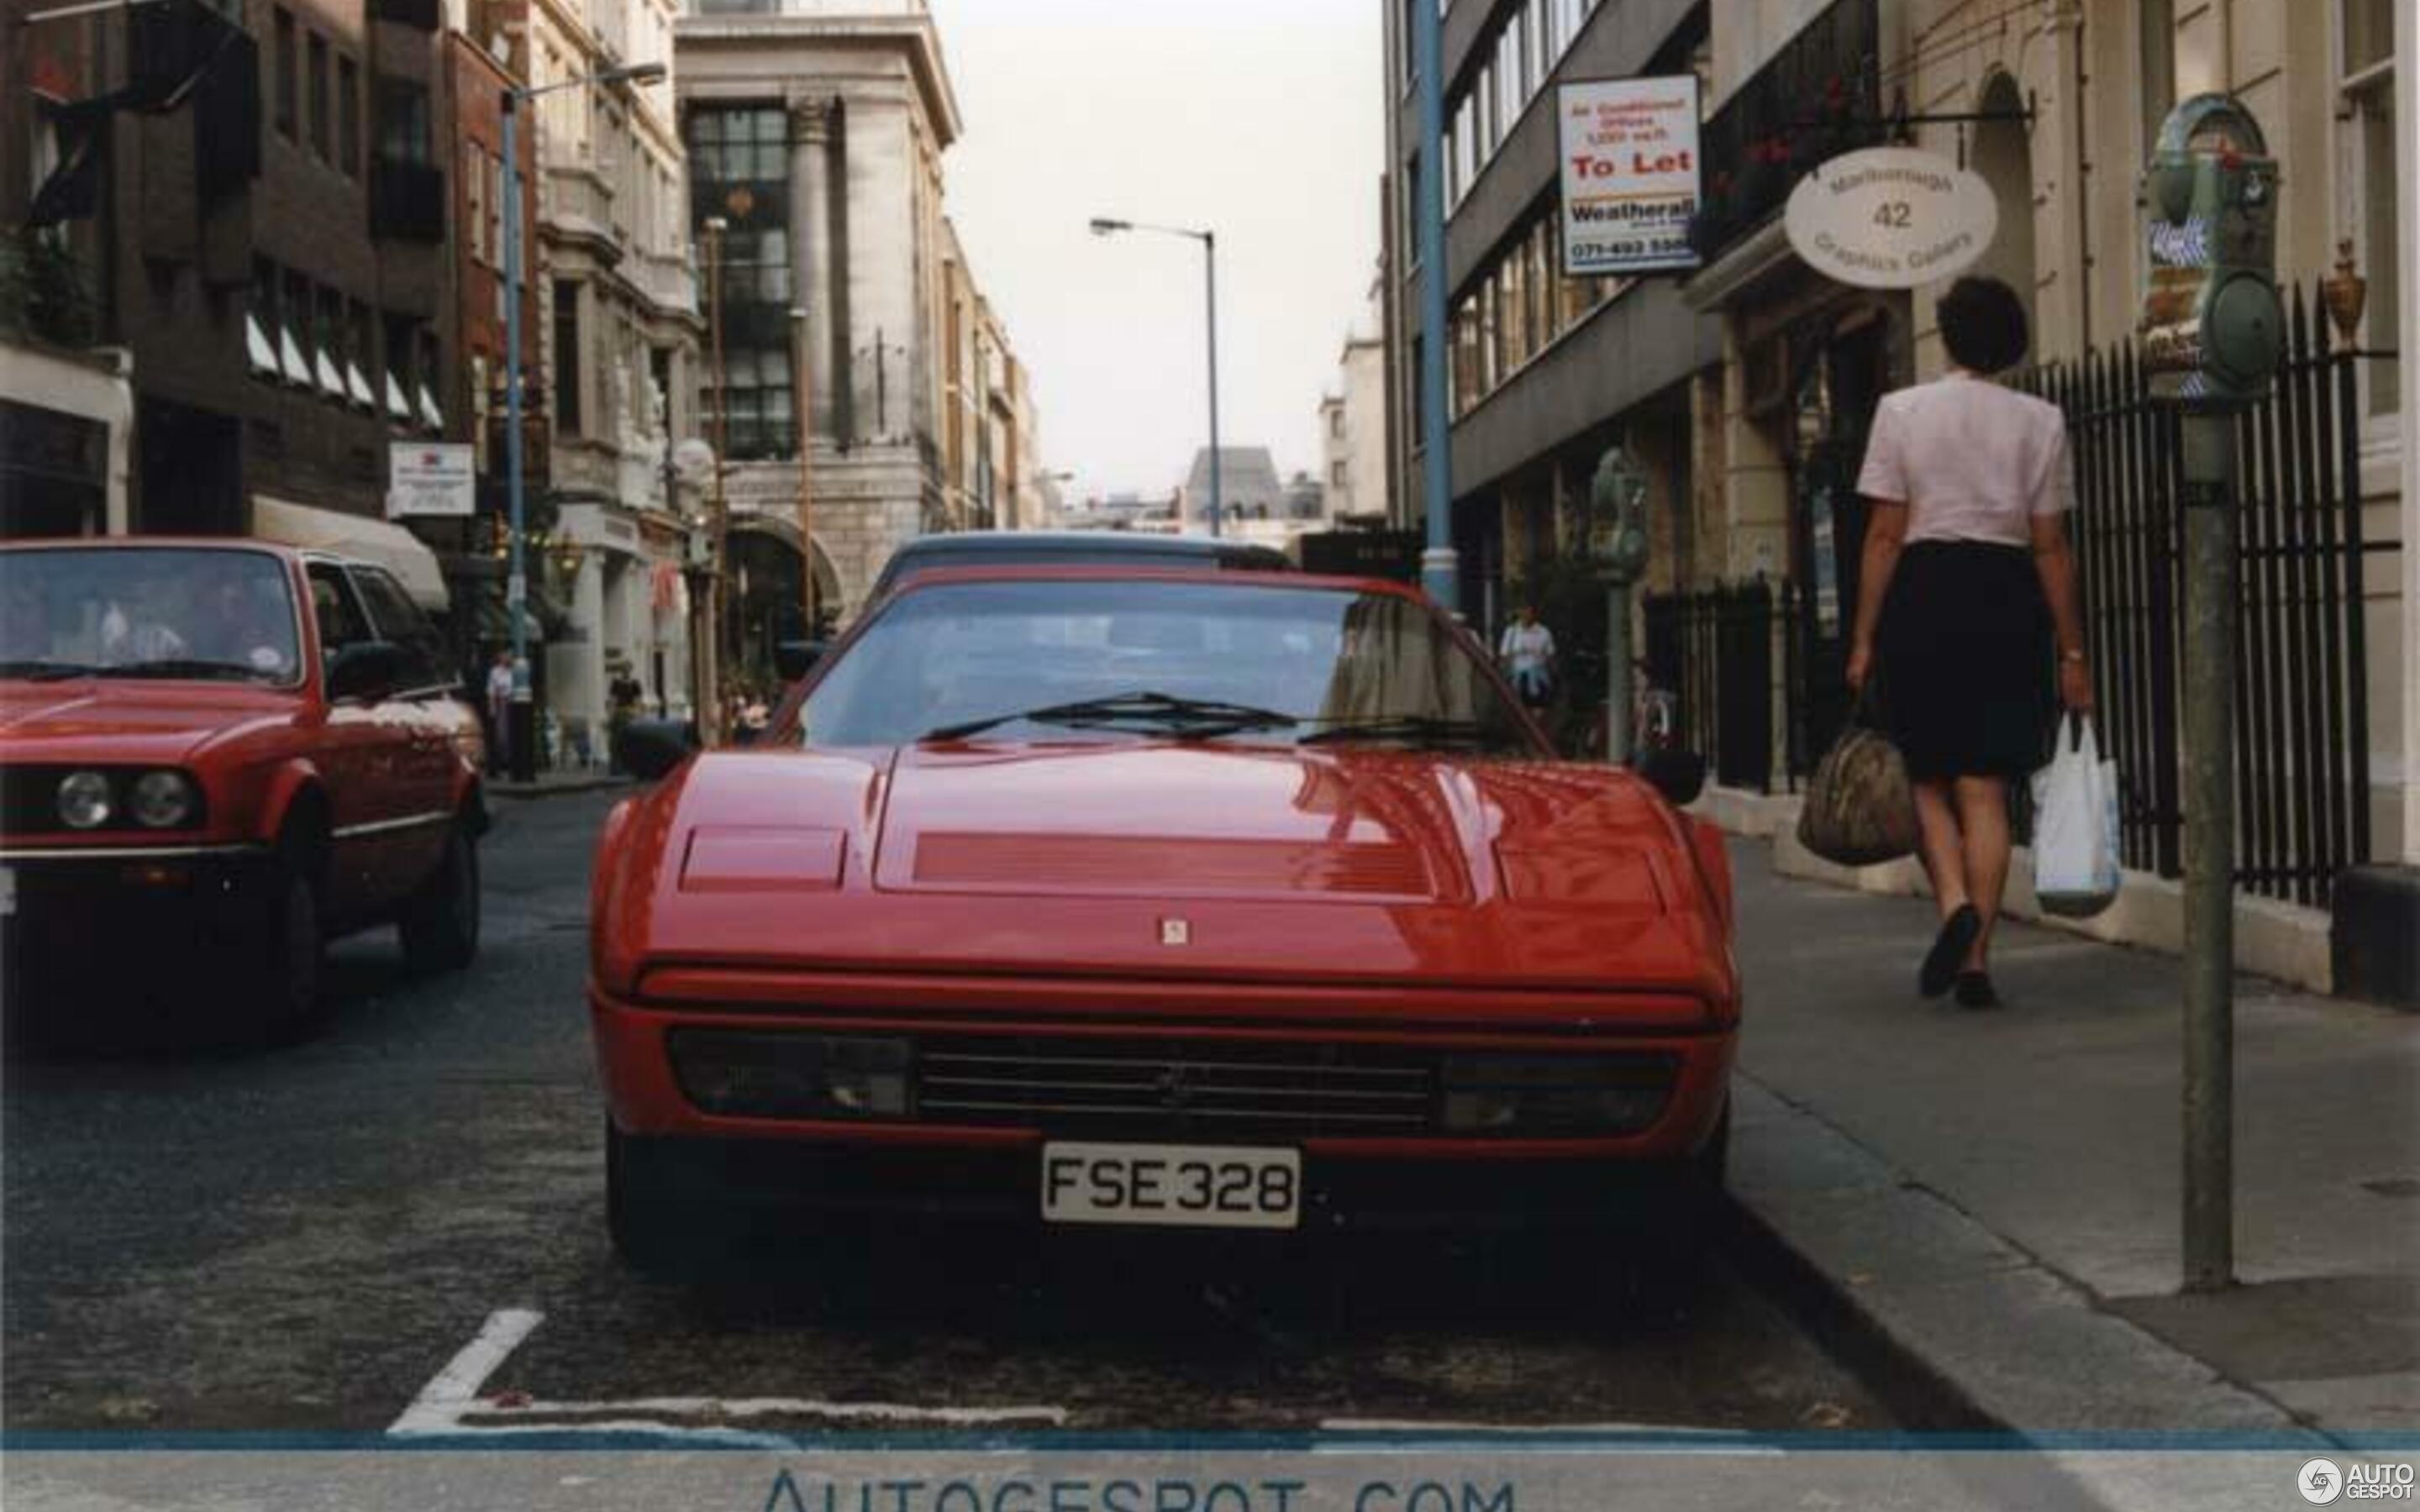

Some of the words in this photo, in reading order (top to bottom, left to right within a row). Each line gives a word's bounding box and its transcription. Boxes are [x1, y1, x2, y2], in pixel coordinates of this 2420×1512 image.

[1572, 156, 1614, 178] To
[1633, 151, 1691, 174] Let
[1828, 170, 1954, 194] Marlborough
[1572, 199, 1694, 221] Weatherall
[1874, 202, 1912, 228] 42
[1814, 232, 1901, 270] Graphics
[1907, 232, 1973, 268] Gallery
